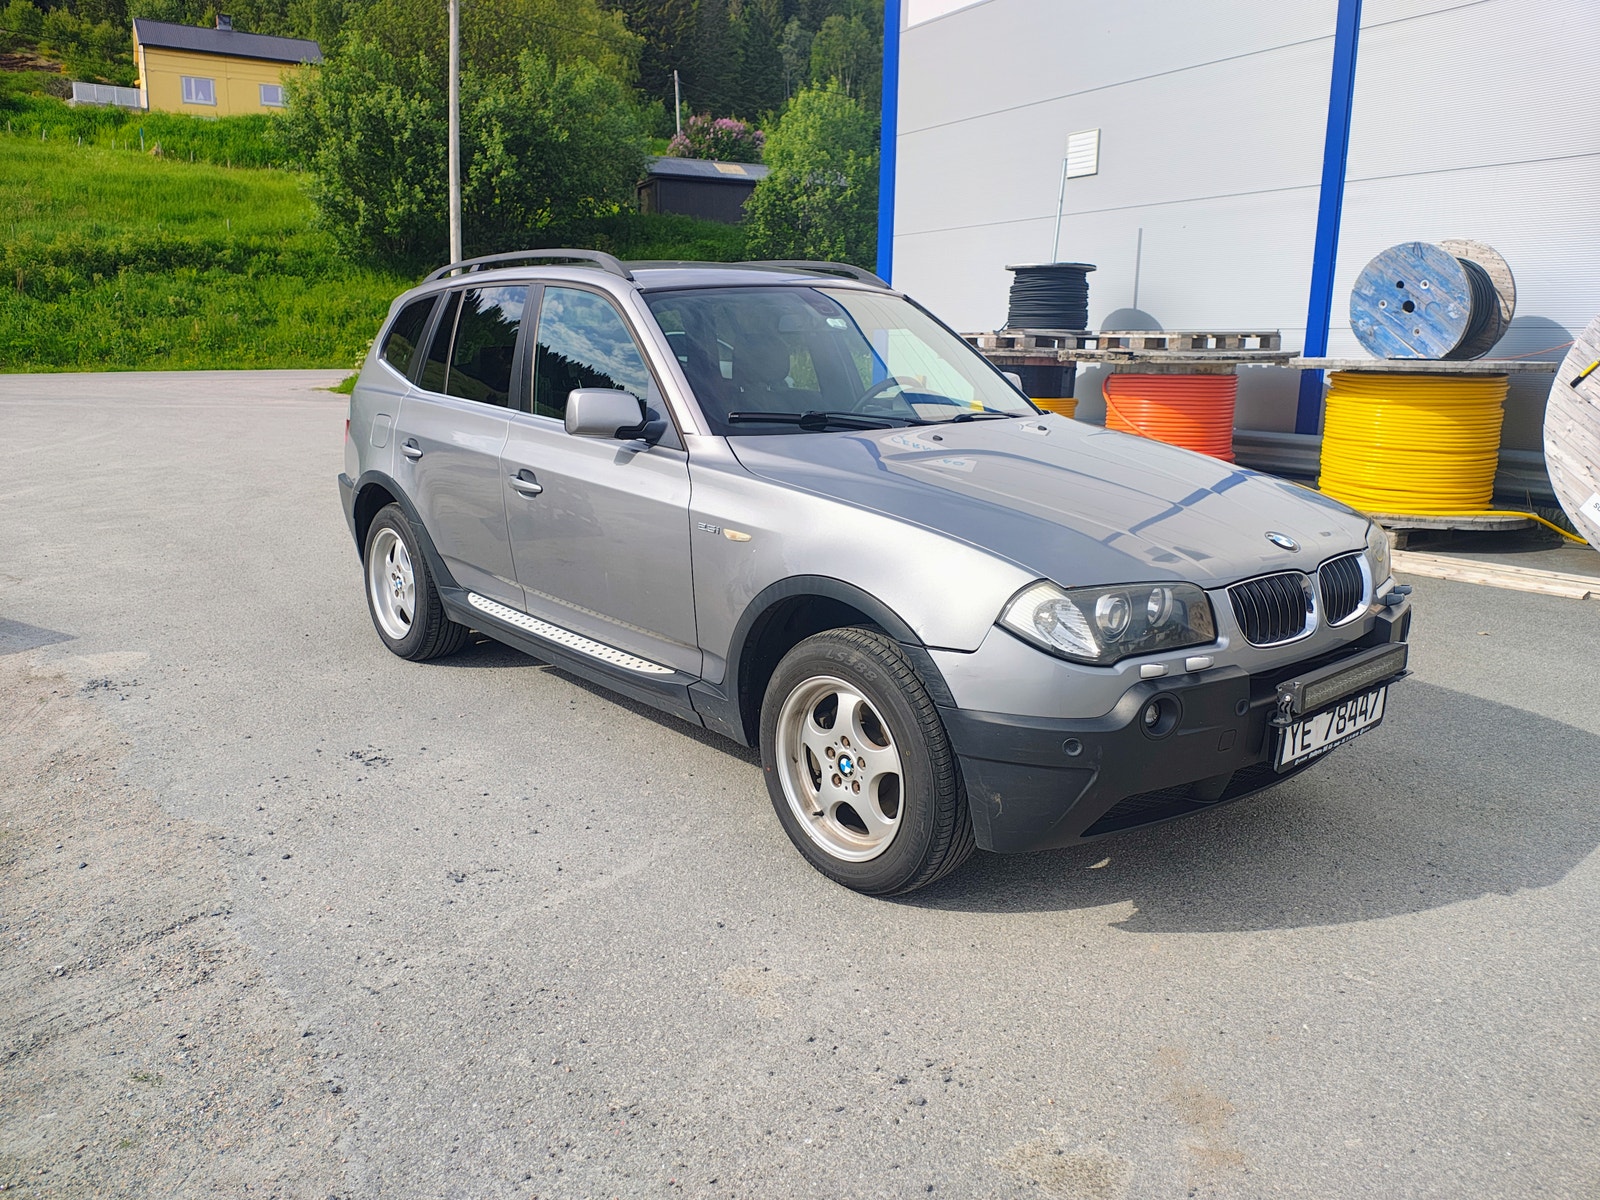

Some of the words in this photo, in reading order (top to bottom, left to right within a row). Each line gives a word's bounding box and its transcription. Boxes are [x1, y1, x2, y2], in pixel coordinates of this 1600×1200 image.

[824, 648, 879, 681] LS388
[1290, 719, 1313, 756] YE
[1324, 689, 1381, 741] 78447
